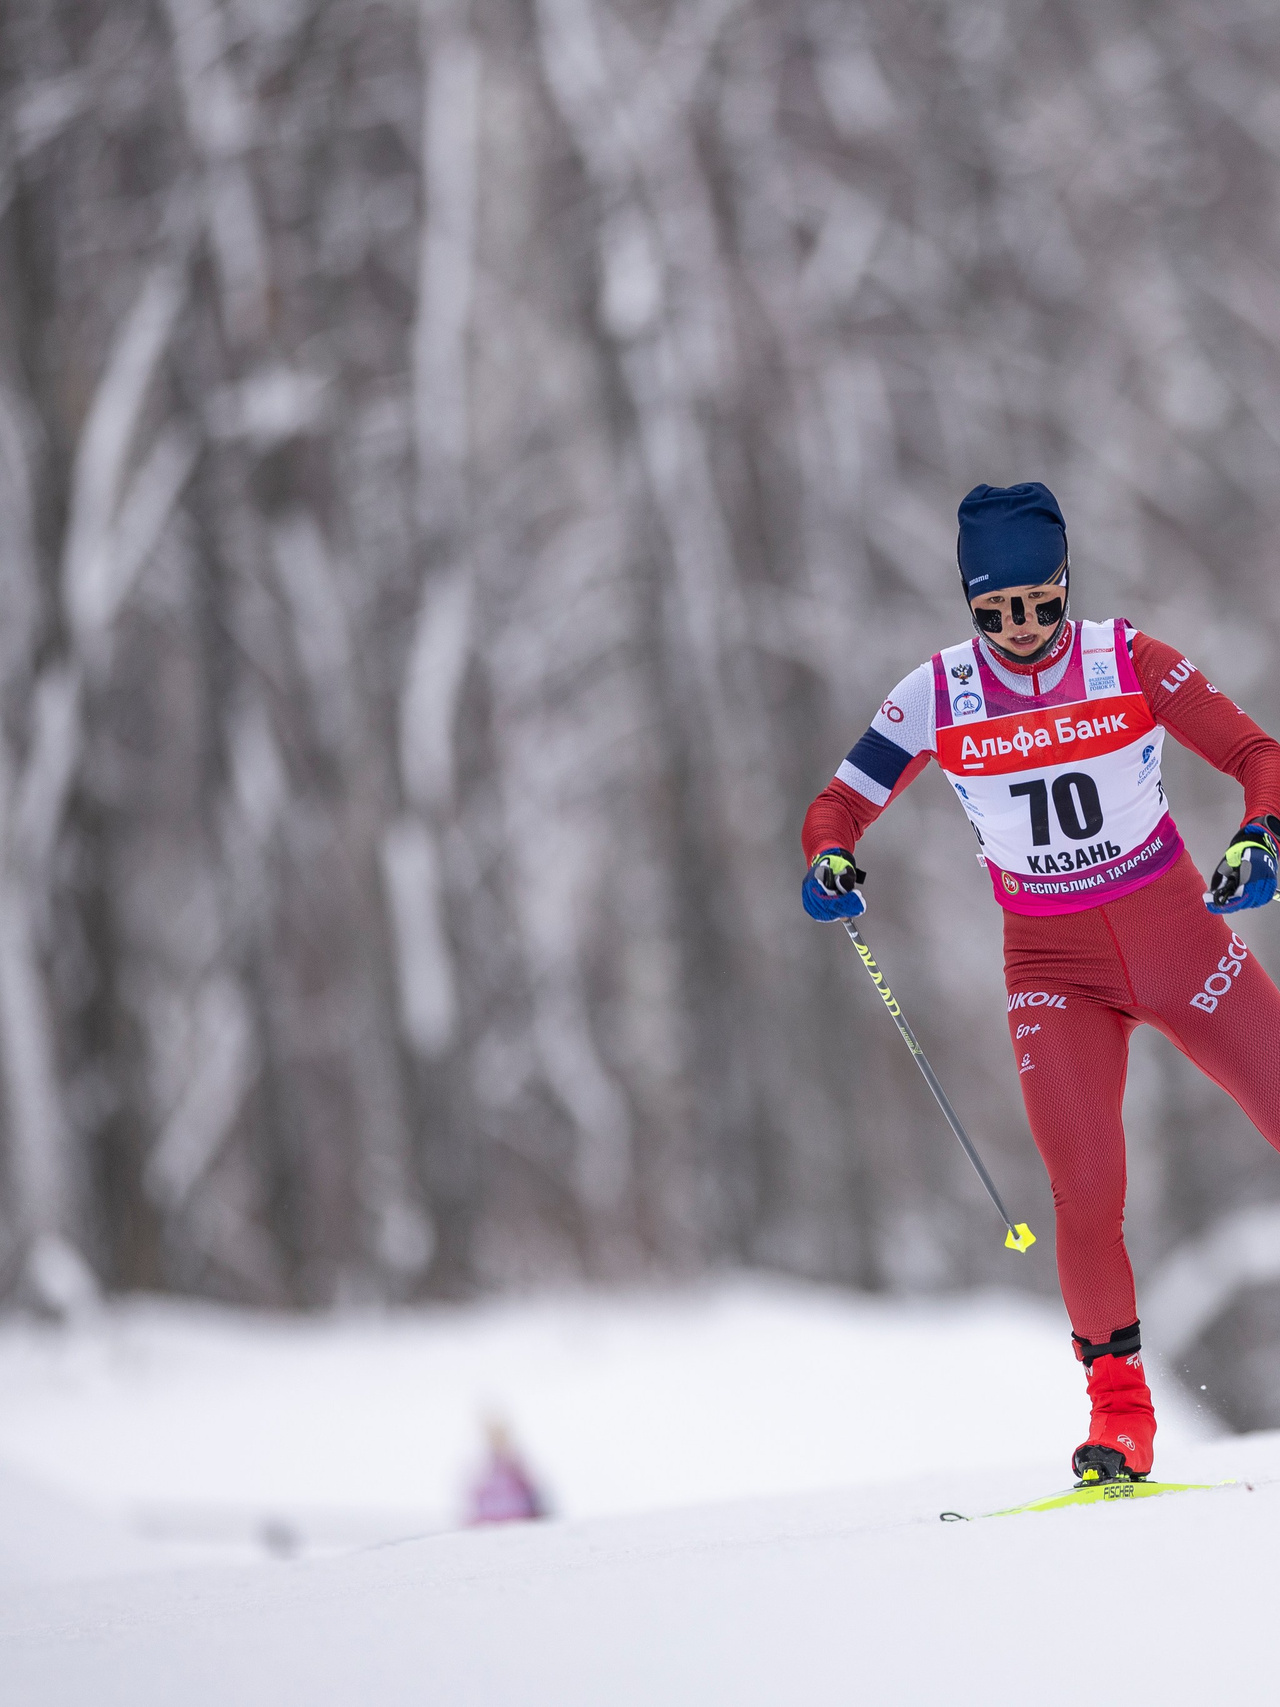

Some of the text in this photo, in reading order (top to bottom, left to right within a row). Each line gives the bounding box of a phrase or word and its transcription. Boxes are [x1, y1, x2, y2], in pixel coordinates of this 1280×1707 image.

[961, 712, 1129, 758] Альфа Банк
[1008, 771, 1104, 847] 70
[1022, 836, 1164, 895] РЕСПУБЛИКА ТАТАРСТАН
[1026, 840, 1122, 874] КАЗАНЬ
[1189, 931, 1248, 1014] BOSCO
[1103, 1484, 1135, 1500] FISCHER
